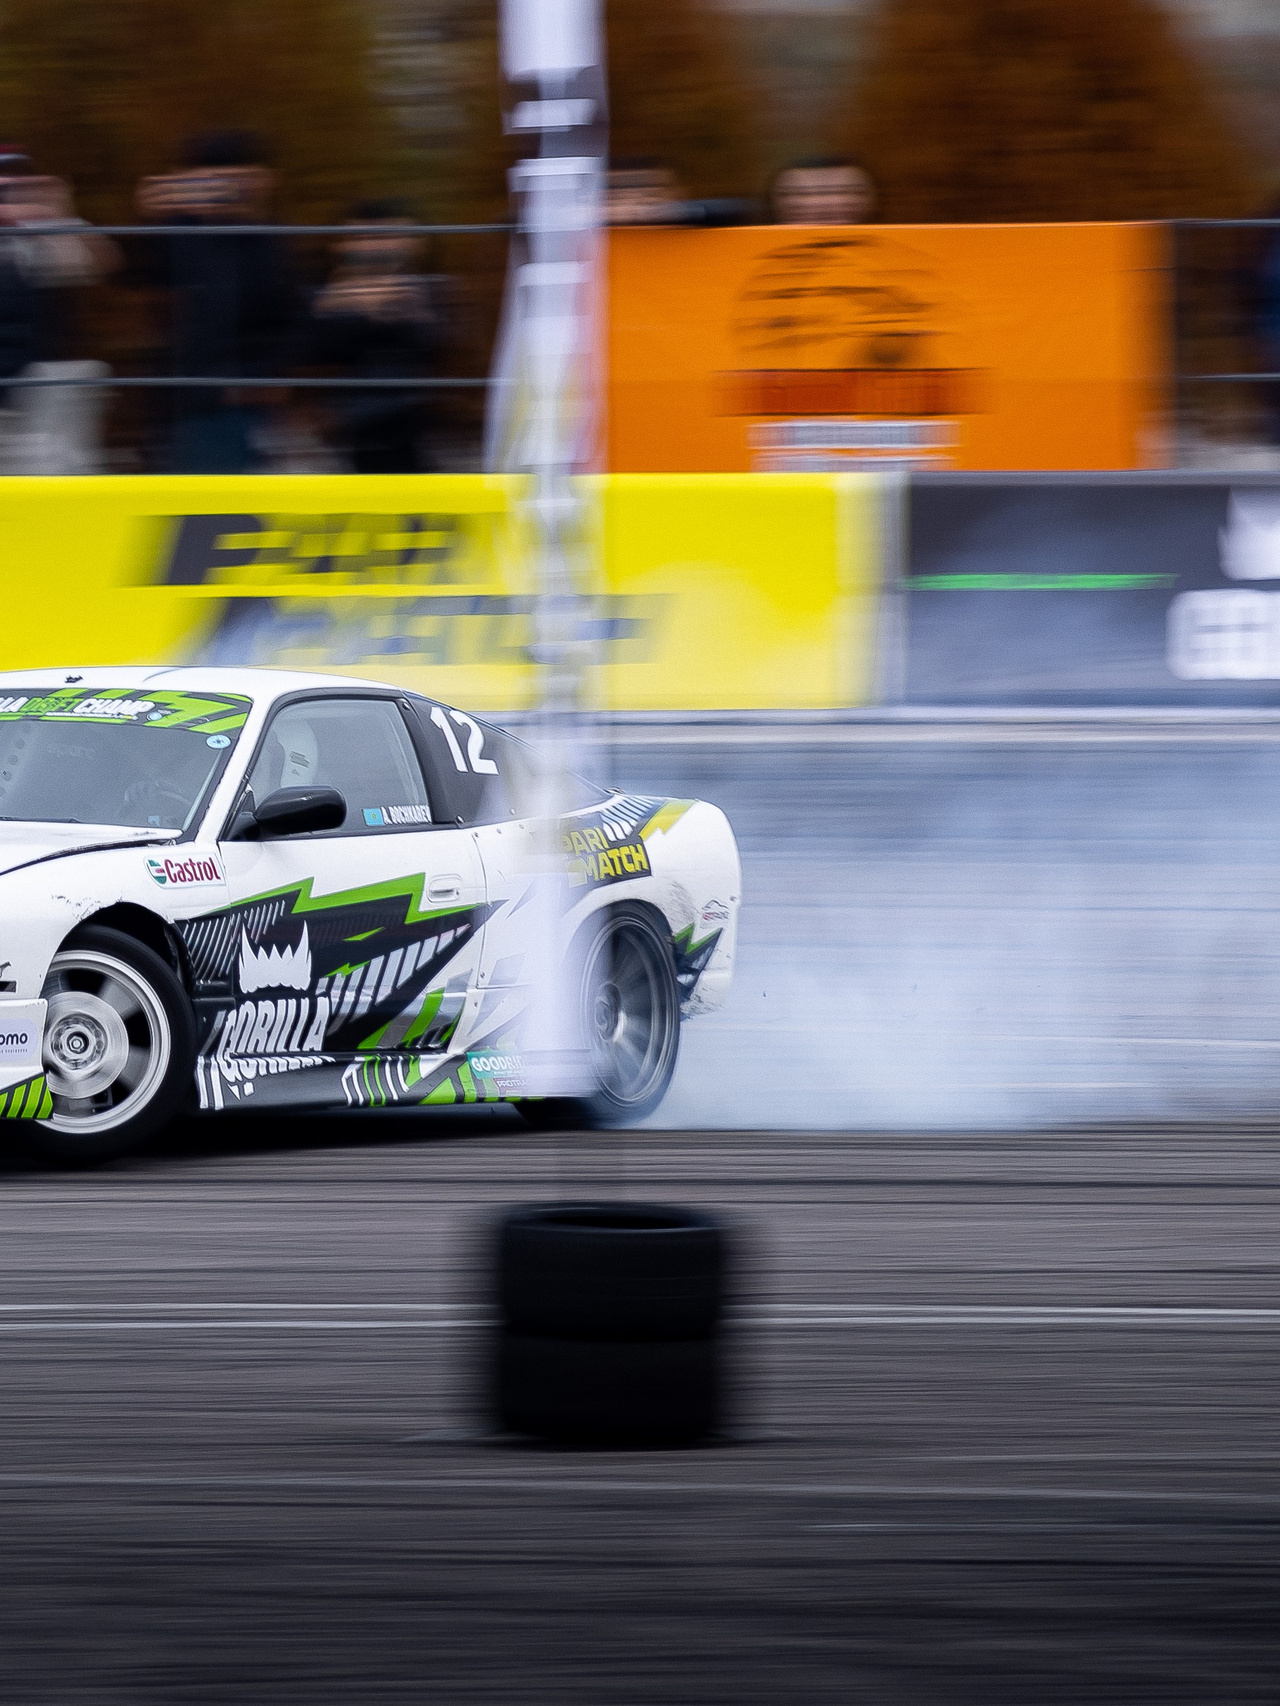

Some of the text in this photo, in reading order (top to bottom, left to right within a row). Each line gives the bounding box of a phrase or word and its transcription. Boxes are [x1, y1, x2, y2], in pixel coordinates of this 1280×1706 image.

[73, 698, 156, 716] CHAMP
[431, 706, 500, 775] 12
[164, 857, 221, 884] Castrol
[573, 844, 650, 881] MATCH
[216, 996, 332, 1078] GORILLA
